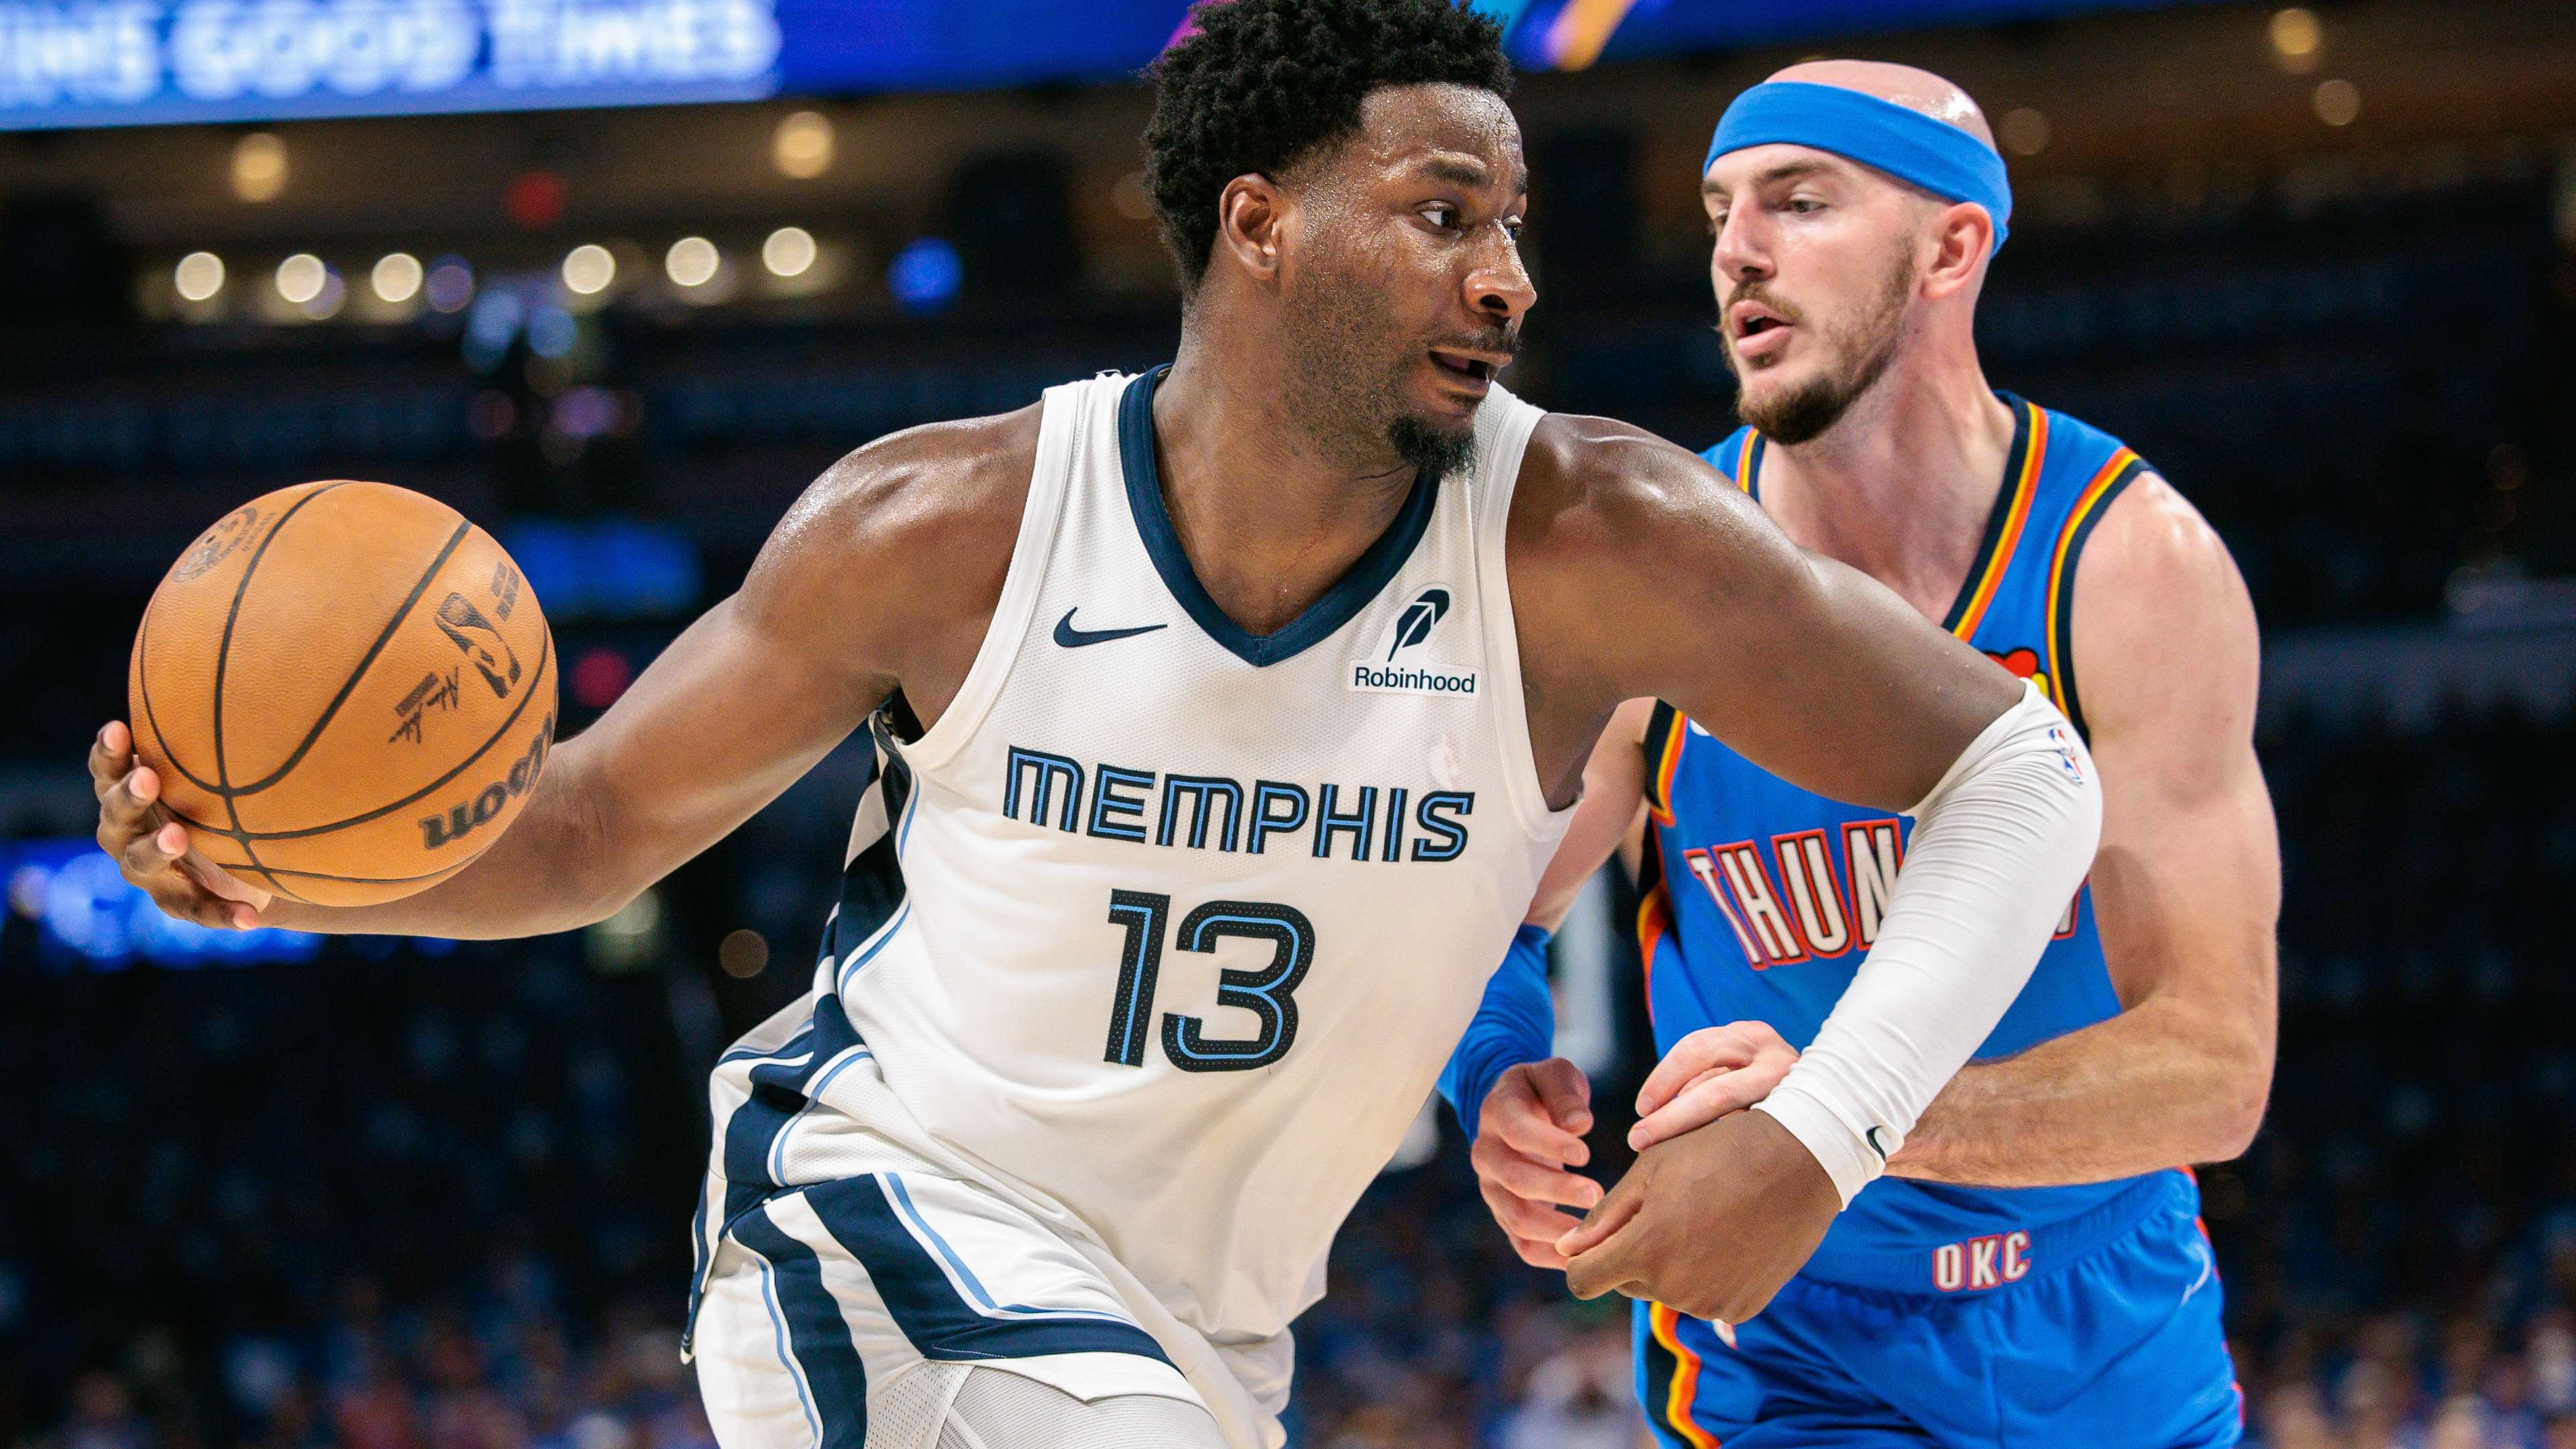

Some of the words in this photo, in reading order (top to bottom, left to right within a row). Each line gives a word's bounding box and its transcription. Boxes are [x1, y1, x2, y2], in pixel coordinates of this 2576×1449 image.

[176, 0, 476, 100] GOOD
[491, 0, 781, 90] TIMES
[1354, 666, 1475, 694] Robinhood
[1002, 744, 1475, 863] MEMPHIS
[1683, 818, 2088, 971] THUN
[1104, 888, 1316, 1073] 13
[1932, 1229, 2032, 1293] OKC
